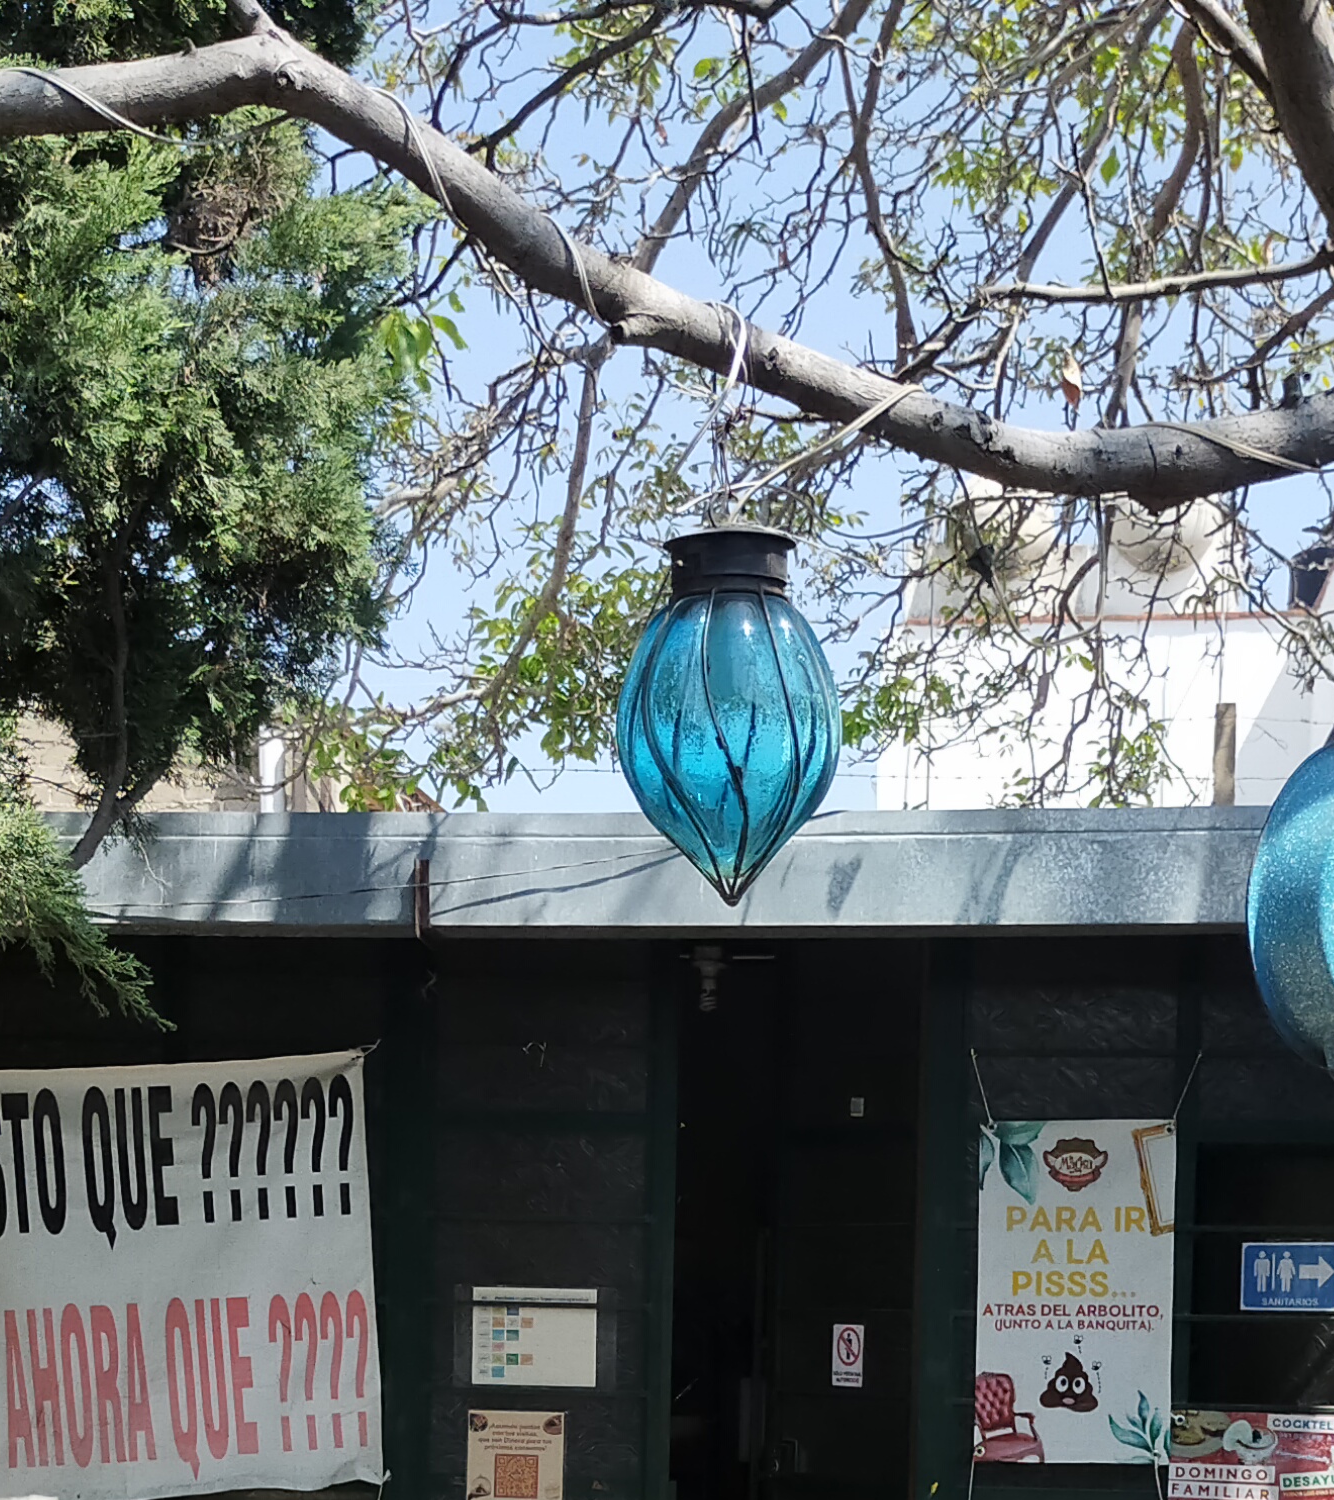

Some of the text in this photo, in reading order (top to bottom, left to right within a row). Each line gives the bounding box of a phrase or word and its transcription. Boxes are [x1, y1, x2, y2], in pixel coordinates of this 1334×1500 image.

[82, 1084, 180, 1250] QUE
[191, 1073, 353, 1224] ??????
[1006, 1206, 1146, 1233] PARA IR
[1031, 1239, 1110, 1264] A LA
[1261, 1297, 1320, 1307] SANITARIOS
[982, 1303, 1164, 1320] ATRAS DEL ARBOLITO,
[994, 1318, 1042, 1332] (JUNTO
[1045, 1320, 1054, 1330] A
[1057, 1320, 1073, 1330] LA
[3, 1302, 157, 1470] AHORA
[165, 1296, 259, 1482] QUE
[268, 1288, 370, 1453] ????
[1174, 1466, 1269, 1480] DOMINGO
[1171, 1483, 1271, 1500] FAMILIAR
